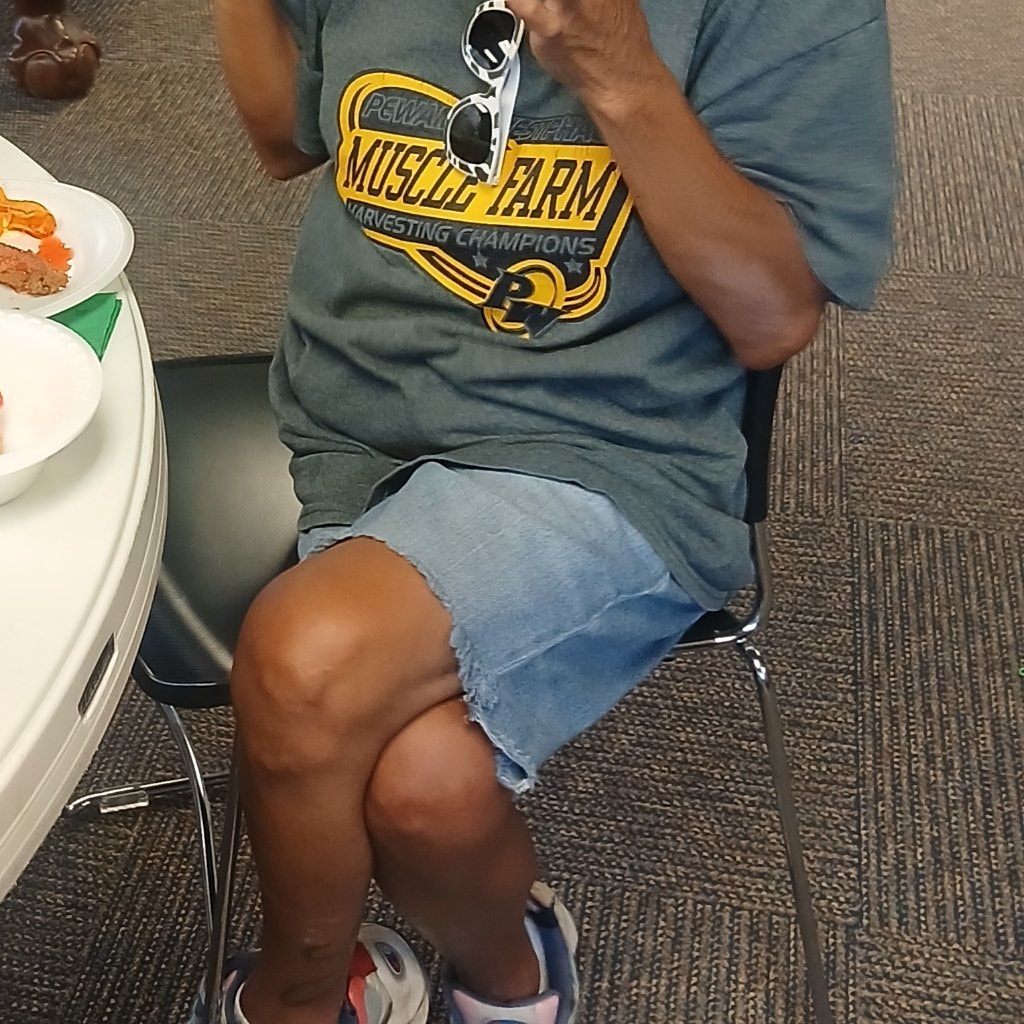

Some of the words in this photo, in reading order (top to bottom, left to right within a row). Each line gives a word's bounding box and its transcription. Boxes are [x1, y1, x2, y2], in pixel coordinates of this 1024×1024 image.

[343, 136, 478, 213] MUSCLE
[486, 157, 617, 221] FARM
[348, 203, 453, 244] HARVESTING
[455, 227, 597, 256] CHAMPIONS
